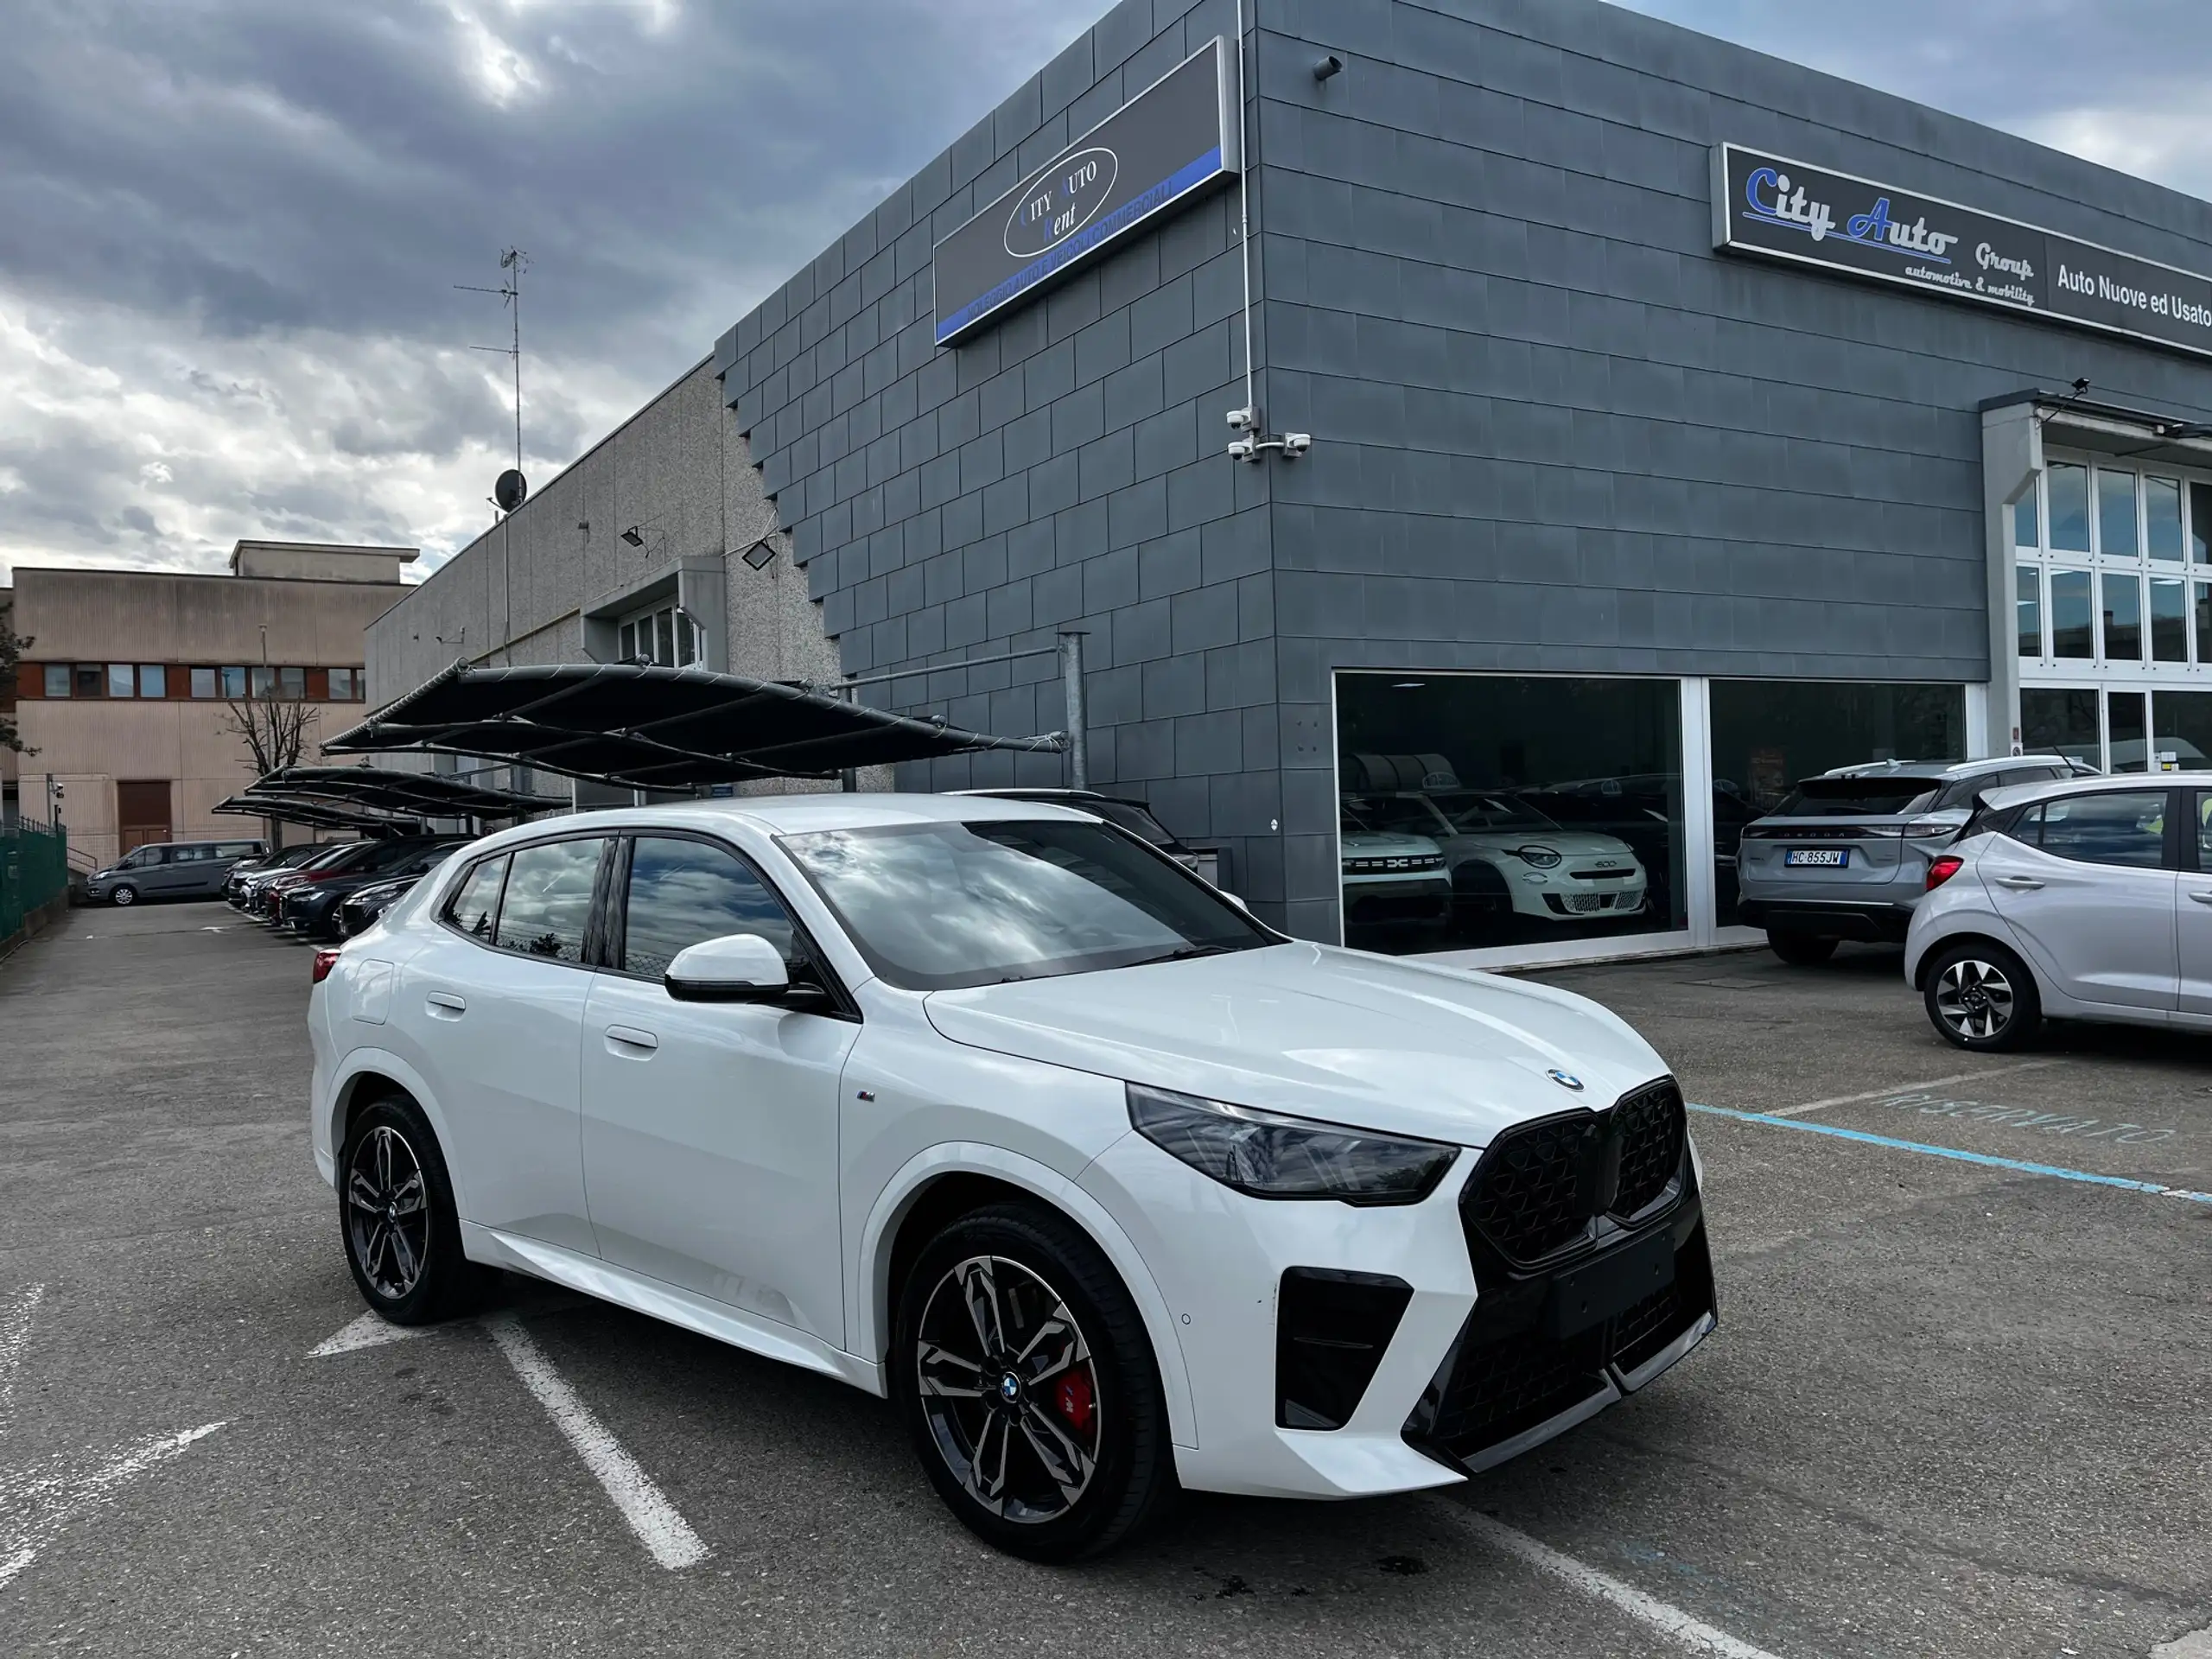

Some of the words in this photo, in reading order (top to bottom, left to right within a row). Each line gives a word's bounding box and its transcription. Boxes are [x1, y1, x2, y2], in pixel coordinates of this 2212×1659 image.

[1044, 202, 1076, 243] Rent
[1092, 180, 1173, 242] COMMERCIALI
[1746, 168, 1836, 241] City
[1847, 197, 1958, 255] Auto
[1975, 243, 2034, 281] Group
[1905, 266, 1973, 289] automotive
[1975, 276, 1985, 292] &
[1987, 284, 2035, 307] mobility
[2057, 264, 2094, 296] Auto
[2099, 275, 2147, 309] Nuove
[2150, 294, 2168, 315] ed
[2171, 296, 2212, 327] Usato
[1791, 849, 1804, 862] HC
[1807, 849, 1840, 864] 855JW
